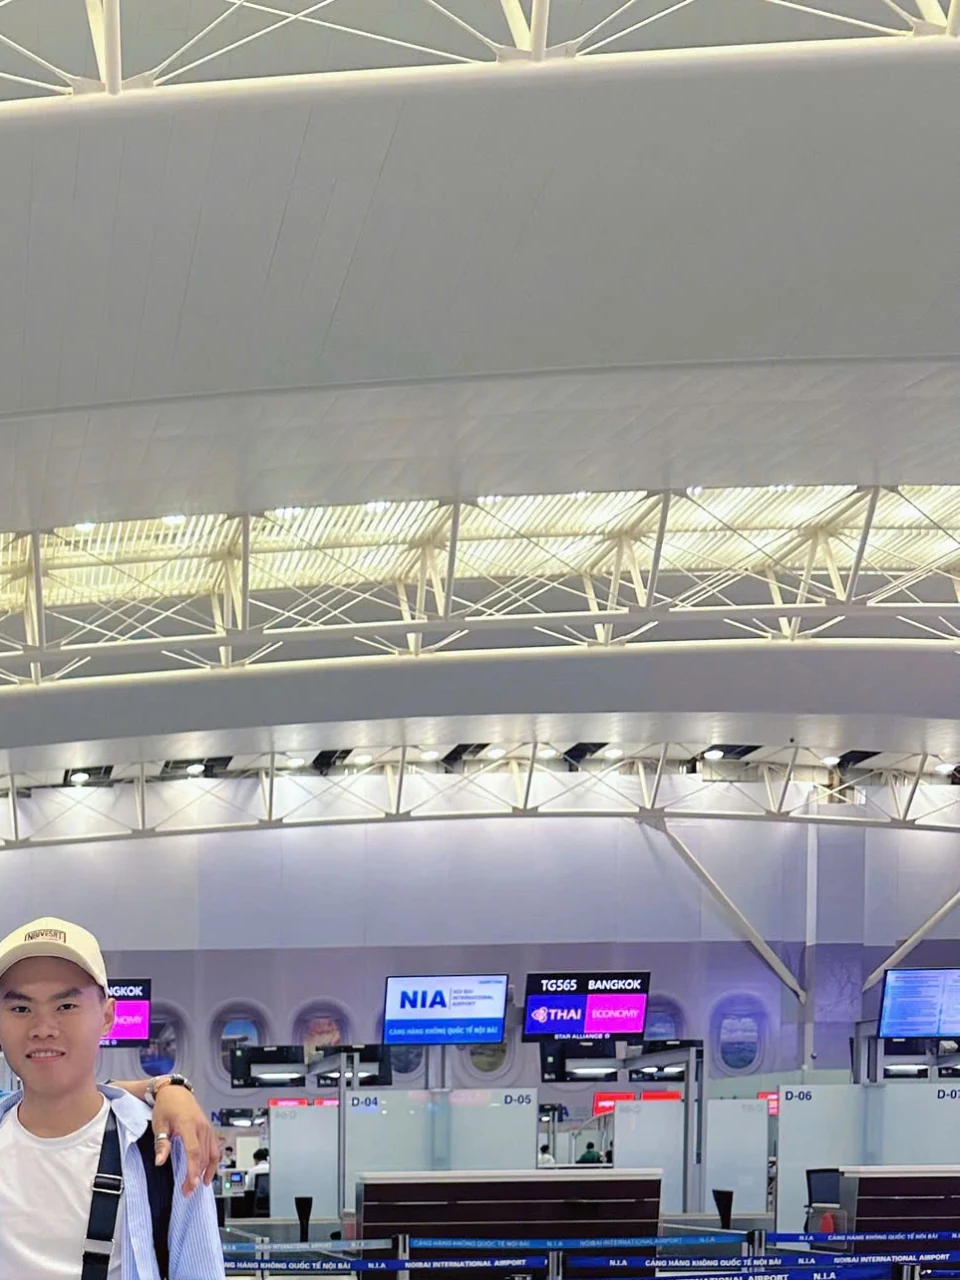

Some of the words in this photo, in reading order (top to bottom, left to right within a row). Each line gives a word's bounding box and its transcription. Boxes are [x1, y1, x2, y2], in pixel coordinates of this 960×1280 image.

[541, 979, 578, 991] TG565
[587, 979, 642, 990] BANGKOK
[107, 986, 143, 996] NGKOK
[400, 990, 447, 1009] NIA
[548, 1009, 582, 1020] THAI
[592, 1010, 639, 1019] ECONOMY
[504, 1094, 532, 1104] D-05
[785, 1091, 812, 1100] D-06
[352, 1097, 378, 1107] D-04
[260, 1261, 287, 1269] KHÔNG
[288, 1260, 310, 1269] QUỐC
[312, 1261, 322, 1269] TẾ
[322, 1262, 336, 1270] NỘI
[692, 1258, 718, 1266] KHÔNG
[720, 1258, 742, 1266] QUỐC
[743, 1258, 752, 1266] TẾ
[860, 1254, 917, 1262] INTERNATIONAL
[814, 1272, 836, 1280] N.I.A
